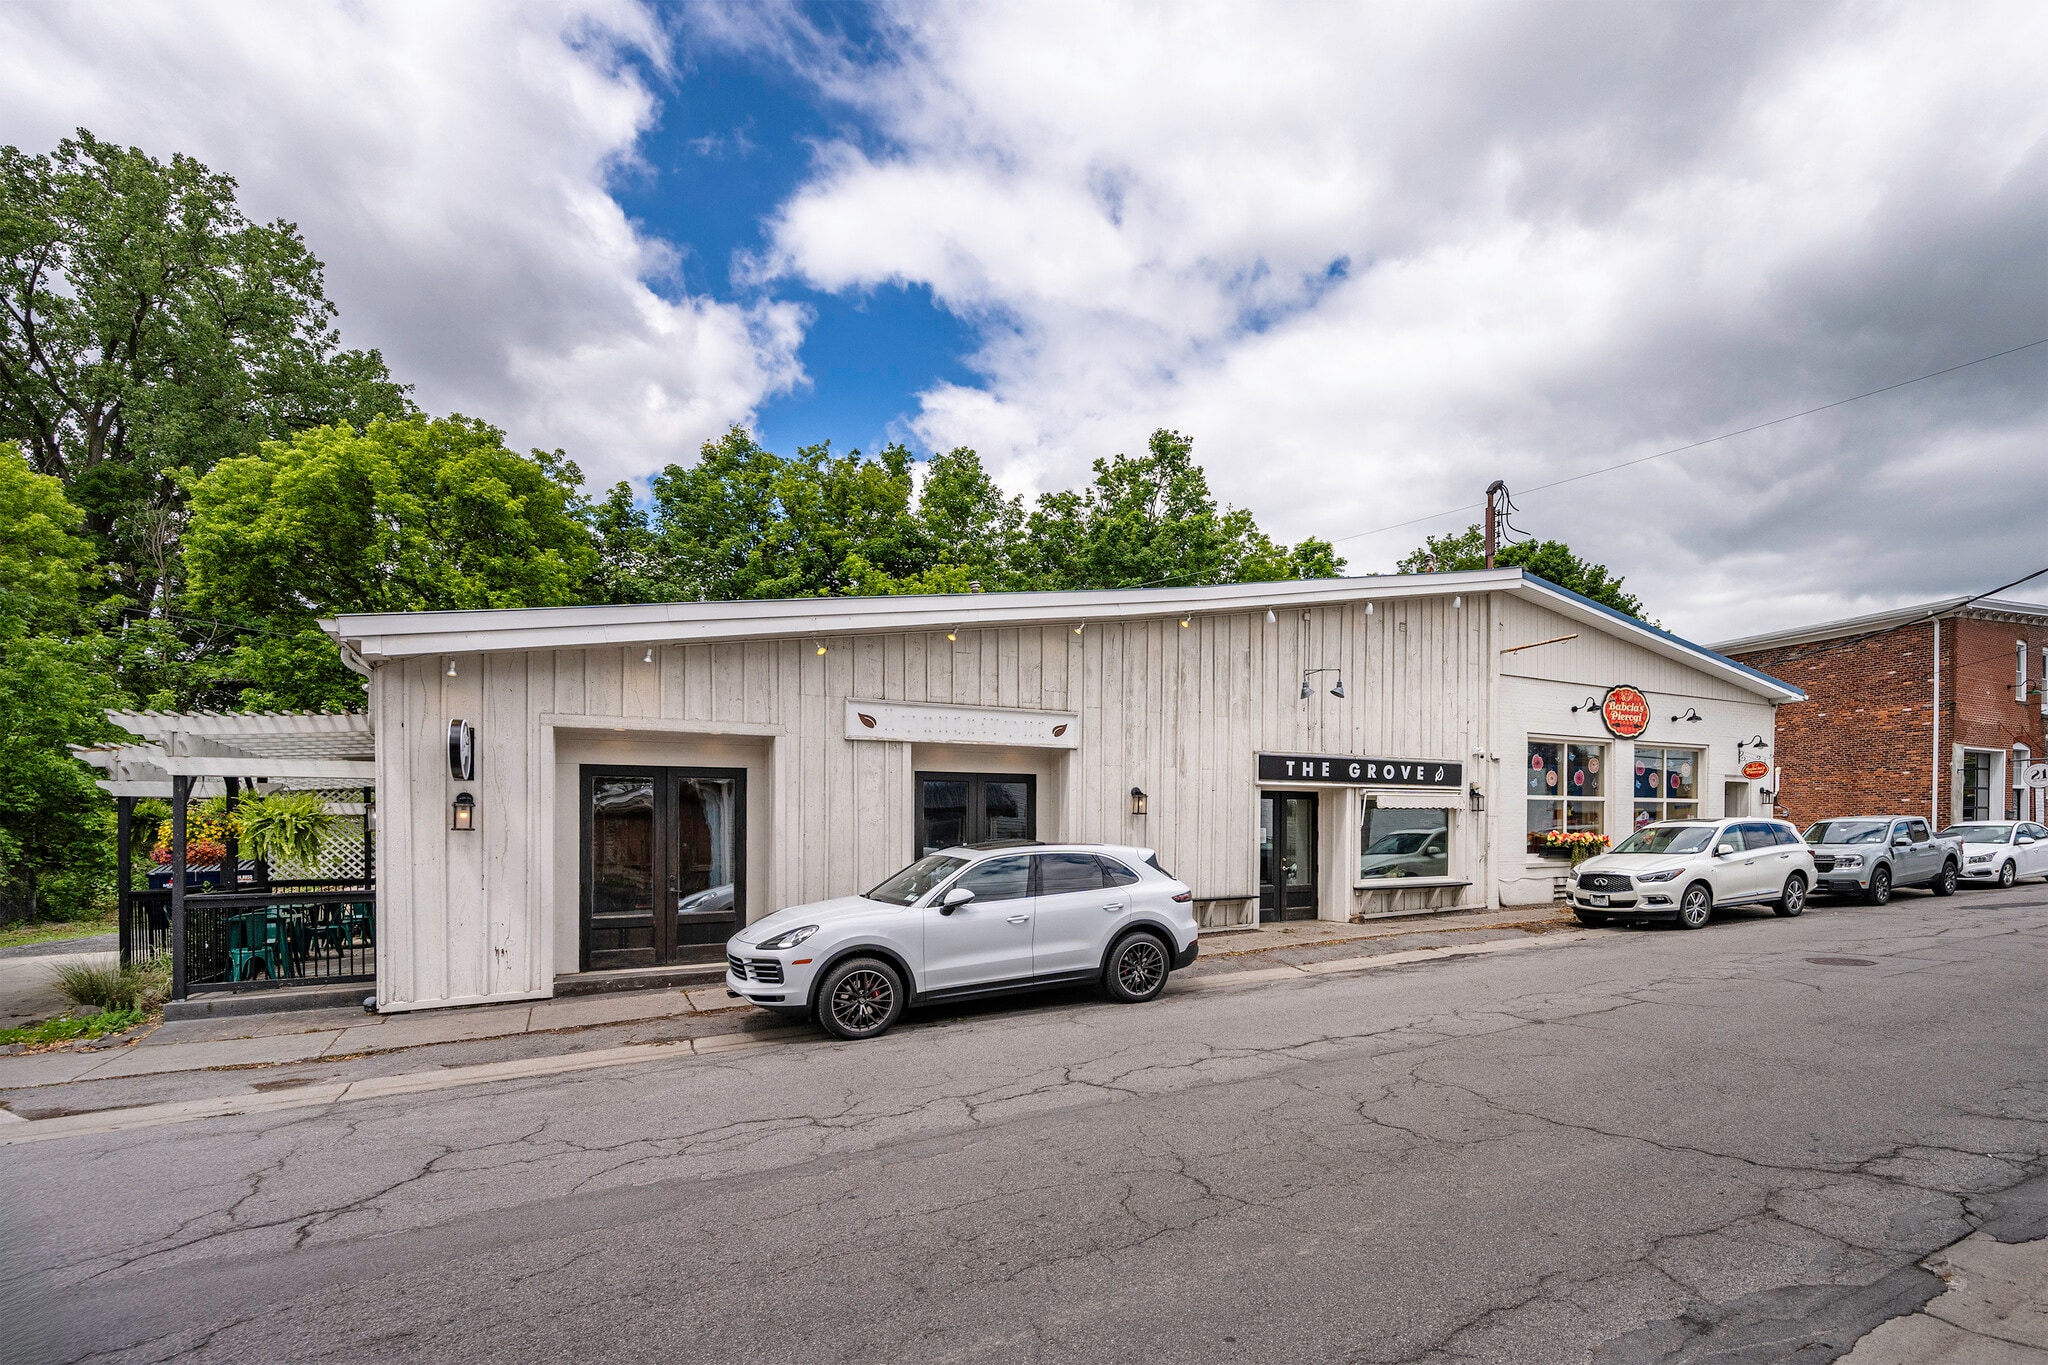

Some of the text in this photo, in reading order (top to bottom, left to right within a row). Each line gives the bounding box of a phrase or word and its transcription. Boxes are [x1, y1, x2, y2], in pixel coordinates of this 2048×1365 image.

[1609, 702, 1644, 713] Babcia's
[1611, 711, 1642, 722] Pierogi
[1286, 761, 1425, 780] THE GROVE
